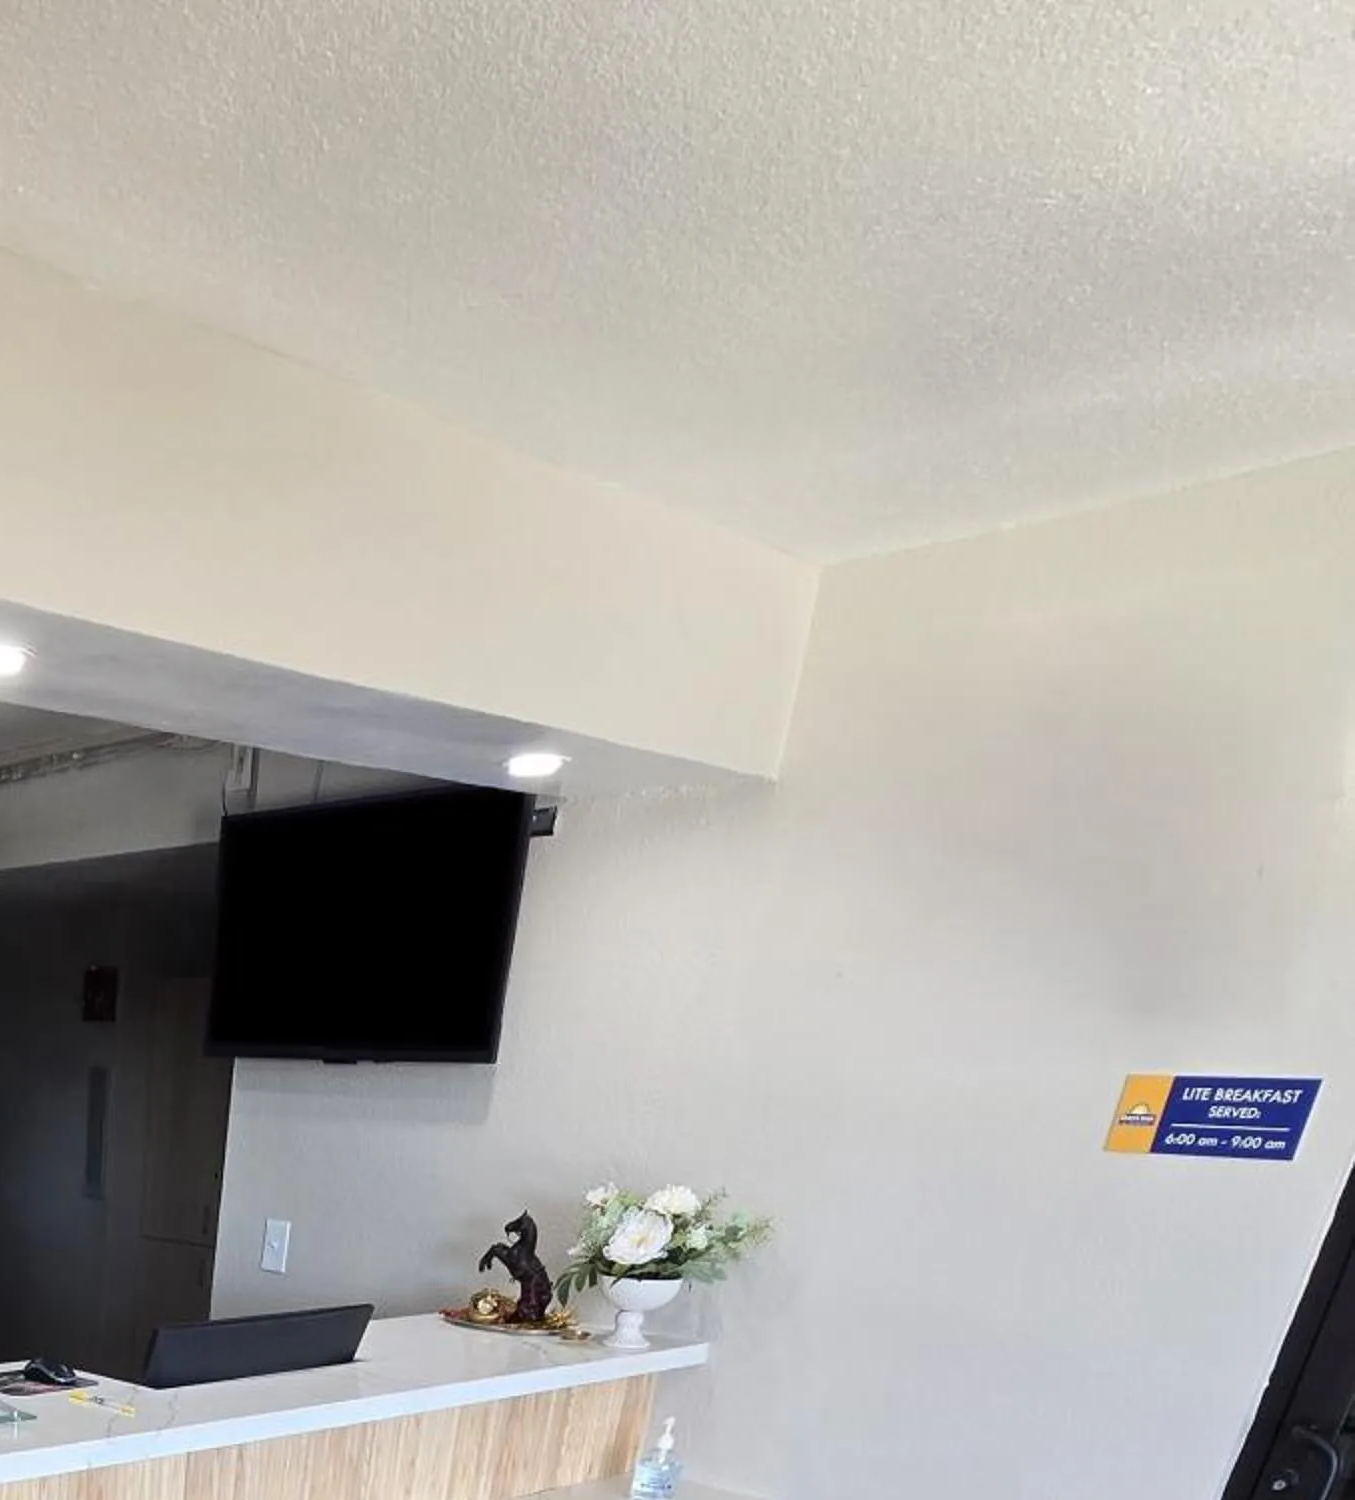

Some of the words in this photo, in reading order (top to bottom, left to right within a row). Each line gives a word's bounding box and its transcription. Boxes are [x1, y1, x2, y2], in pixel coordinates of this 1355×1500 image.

[1182, 1087, 1209, 1101] LITE
[1214, 1087, 1303, 1104] BREAKFAST
[1208, 1105, 1261, 1119] SERVED:
[1164, 1133, 1195, 1146] 6:00
[1197, 1136, 1218, 1147] am
[1231, 1135, 1262, 1149] 9:00
[1265, 1139, 1286, 1149] am
